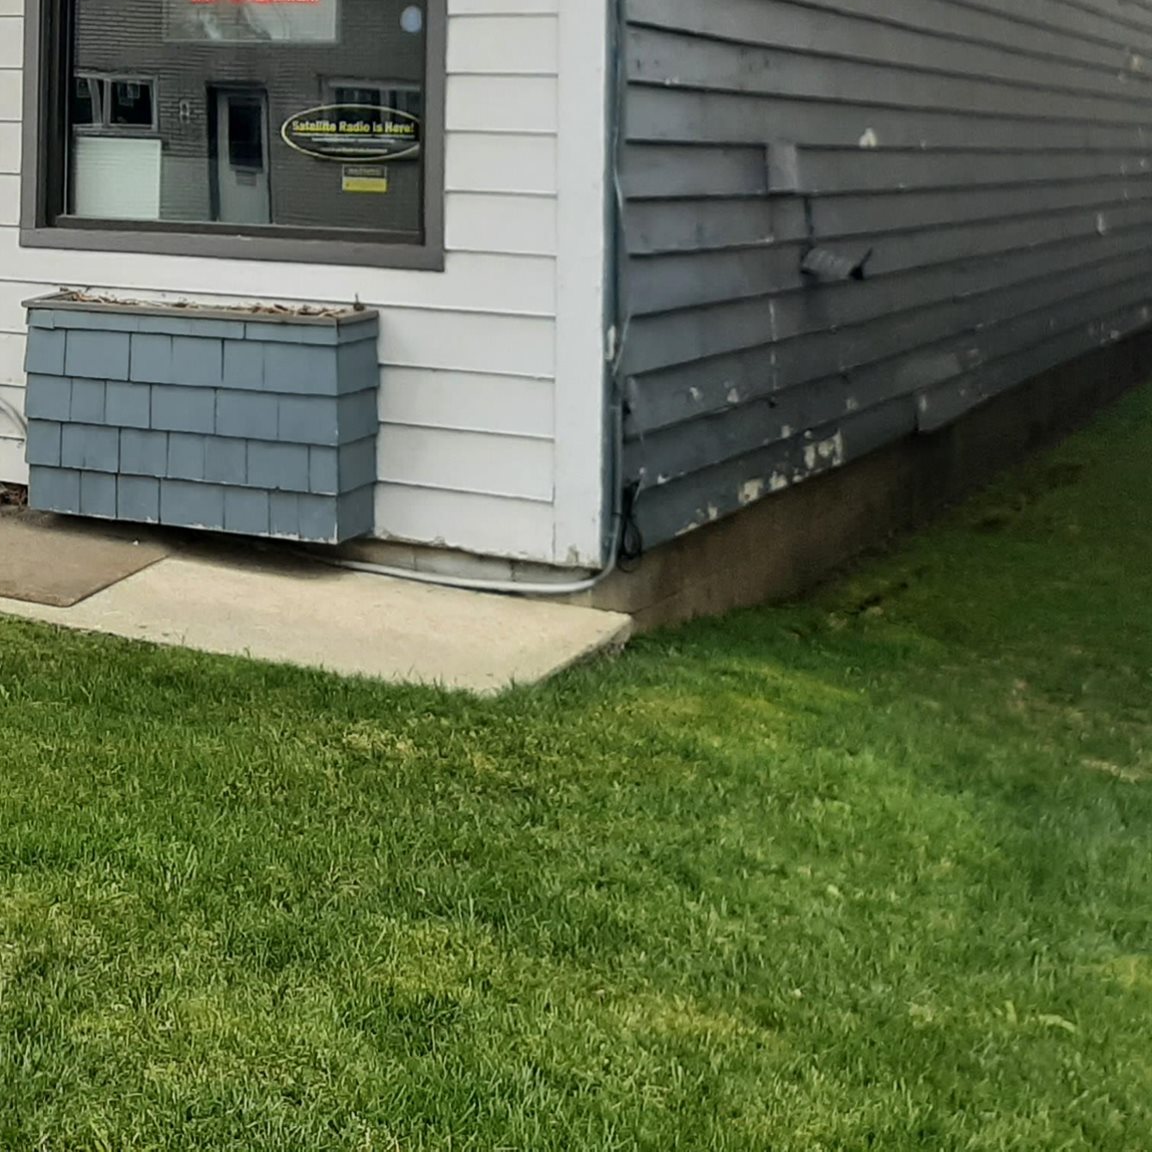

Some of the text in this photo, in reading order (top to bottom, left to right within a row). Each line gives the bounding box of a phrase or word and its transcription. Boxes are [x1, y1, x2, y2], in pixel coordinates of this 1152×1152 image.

[292, 120, 337, 133] Satellite
[338, 120, 371, 133] Radio
[384, 121, 415, 134] Here!
